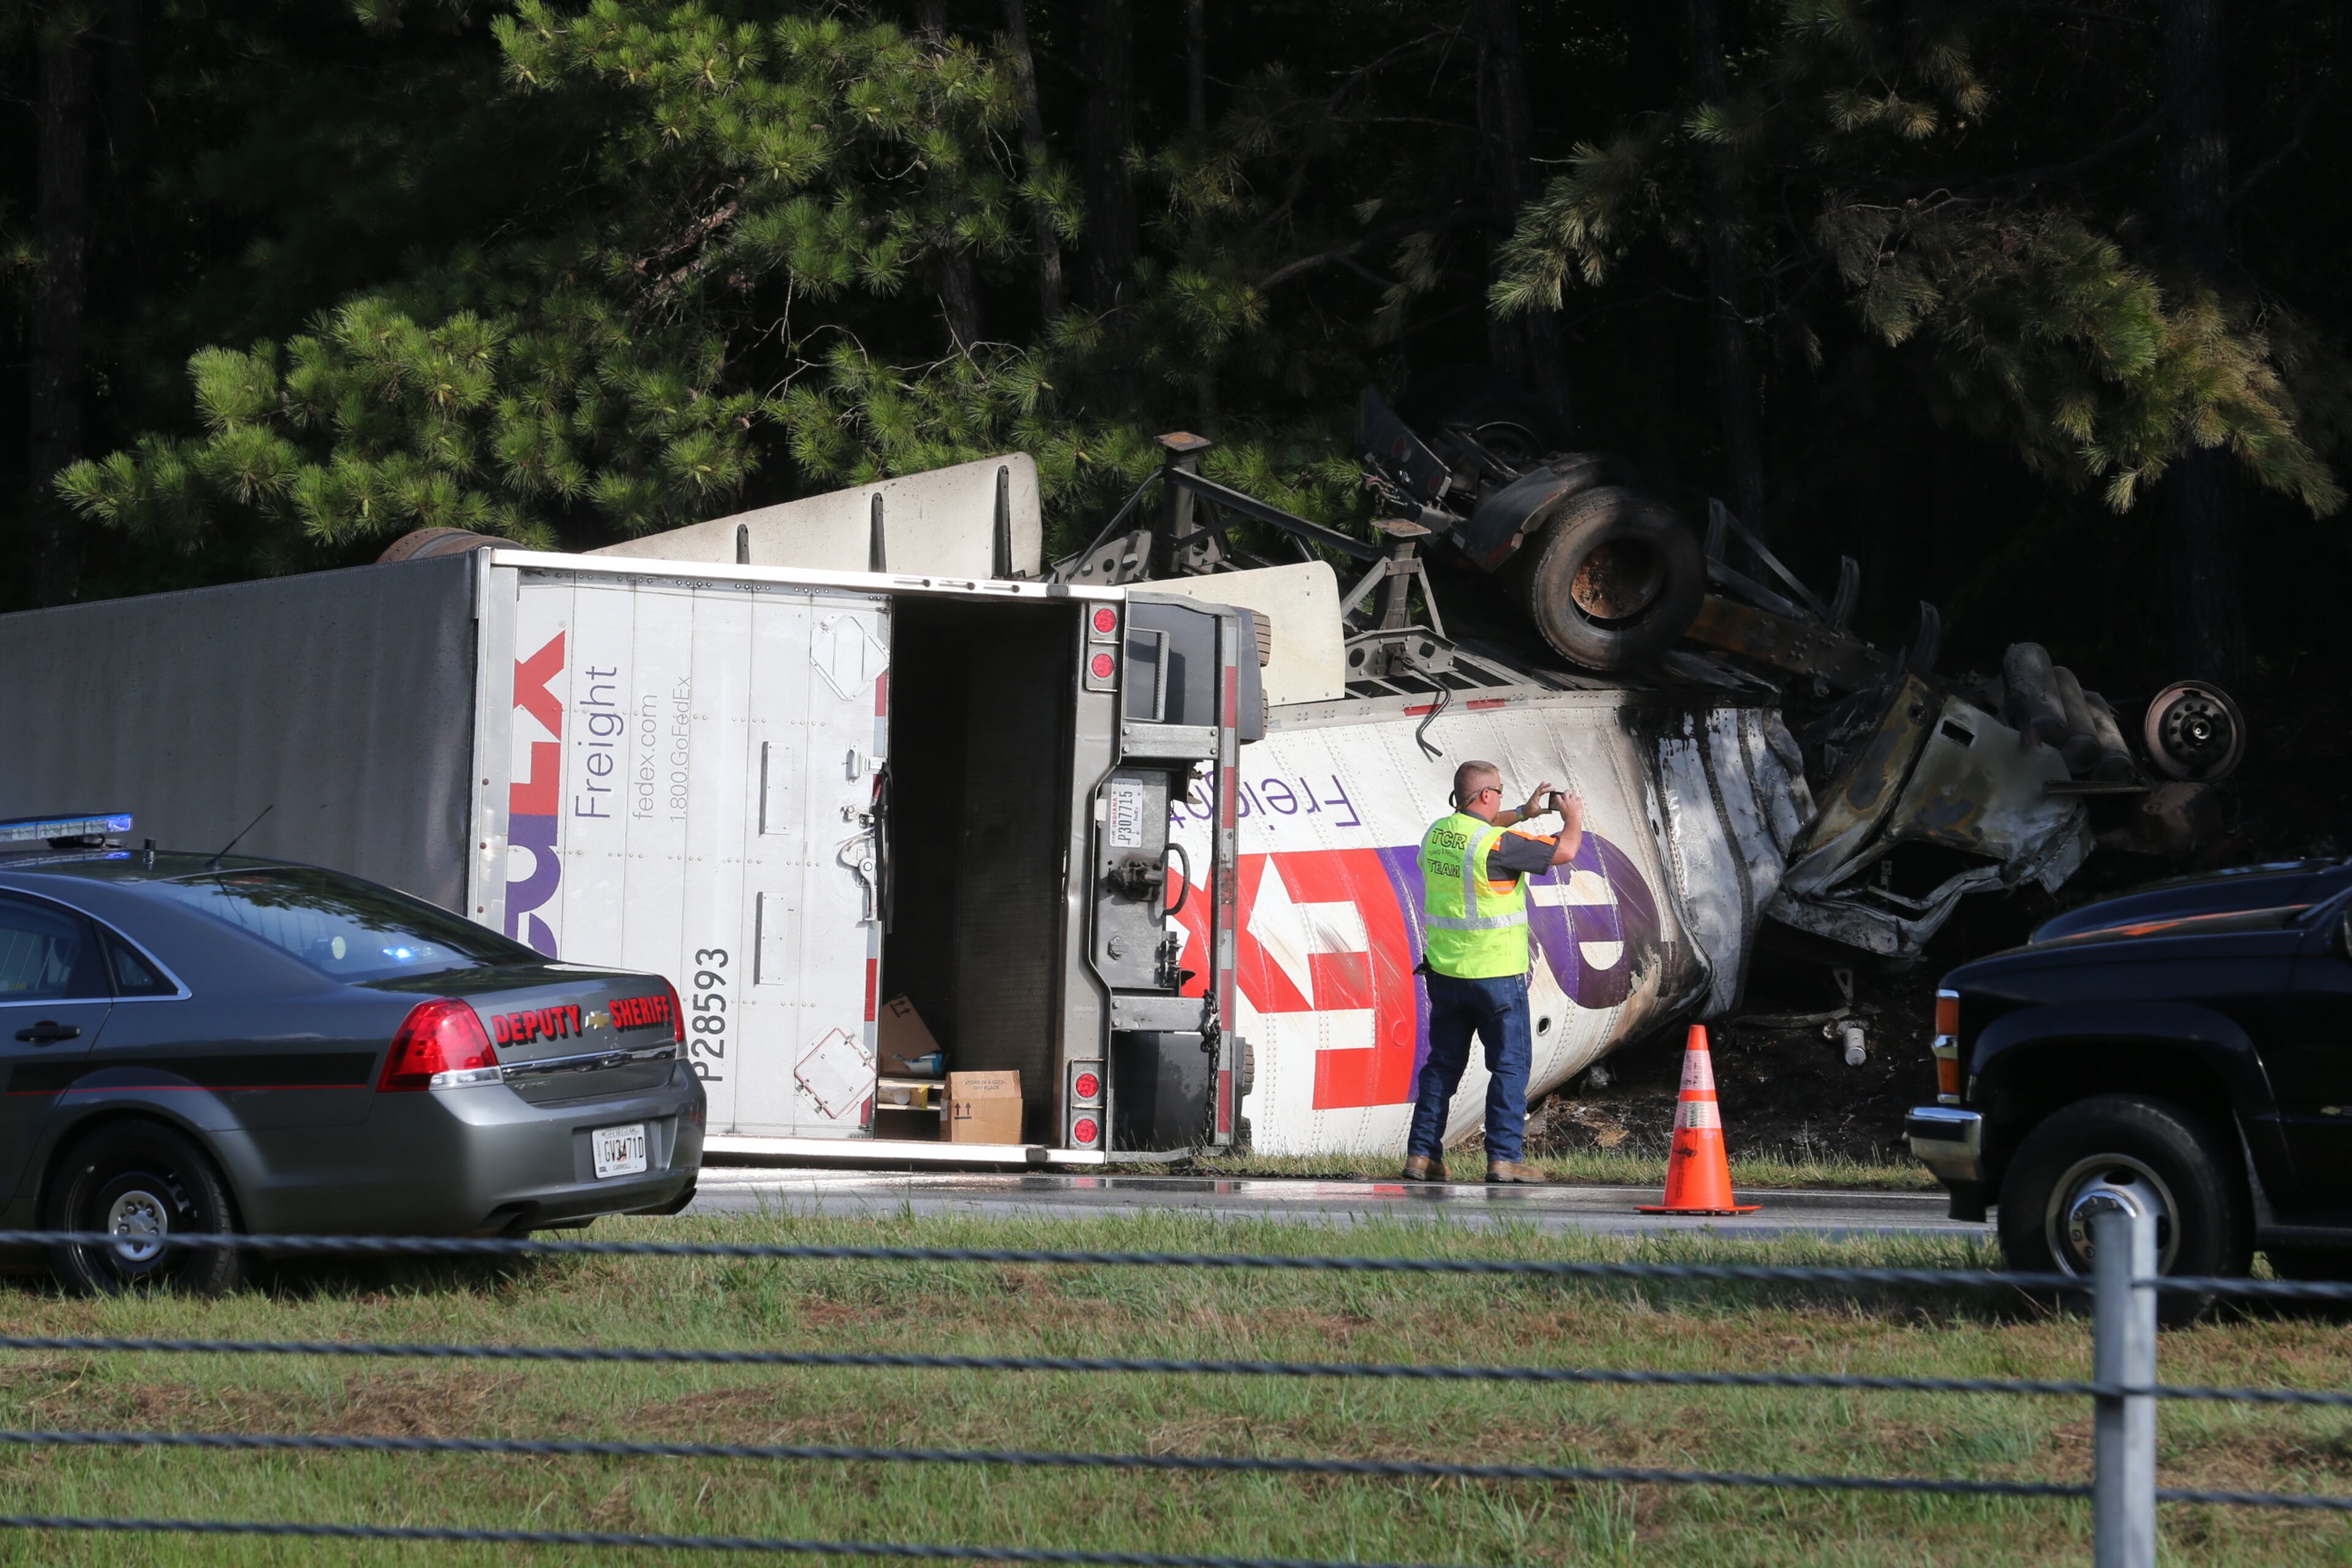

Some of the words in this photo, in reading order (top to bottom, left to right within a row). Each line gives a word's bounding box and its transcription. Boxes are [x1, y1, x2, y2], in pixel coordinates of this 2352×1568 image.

[575, 665, 624, 818] Freight
[633, 693, 658, 821] fedex.com
[669, 676, 691, 822] 1.800.GoFedEx
[1118, 791, 1133, 840] P307715
[1432, 827, 1468, 850] TCR
[1427, 858, 1460, 878] TEAM
[491, 1005, 581, 1046] DEPUTY
[608, 995, 671, 1030] SHERIFF
[691, 949, 728, 1082] P28593
